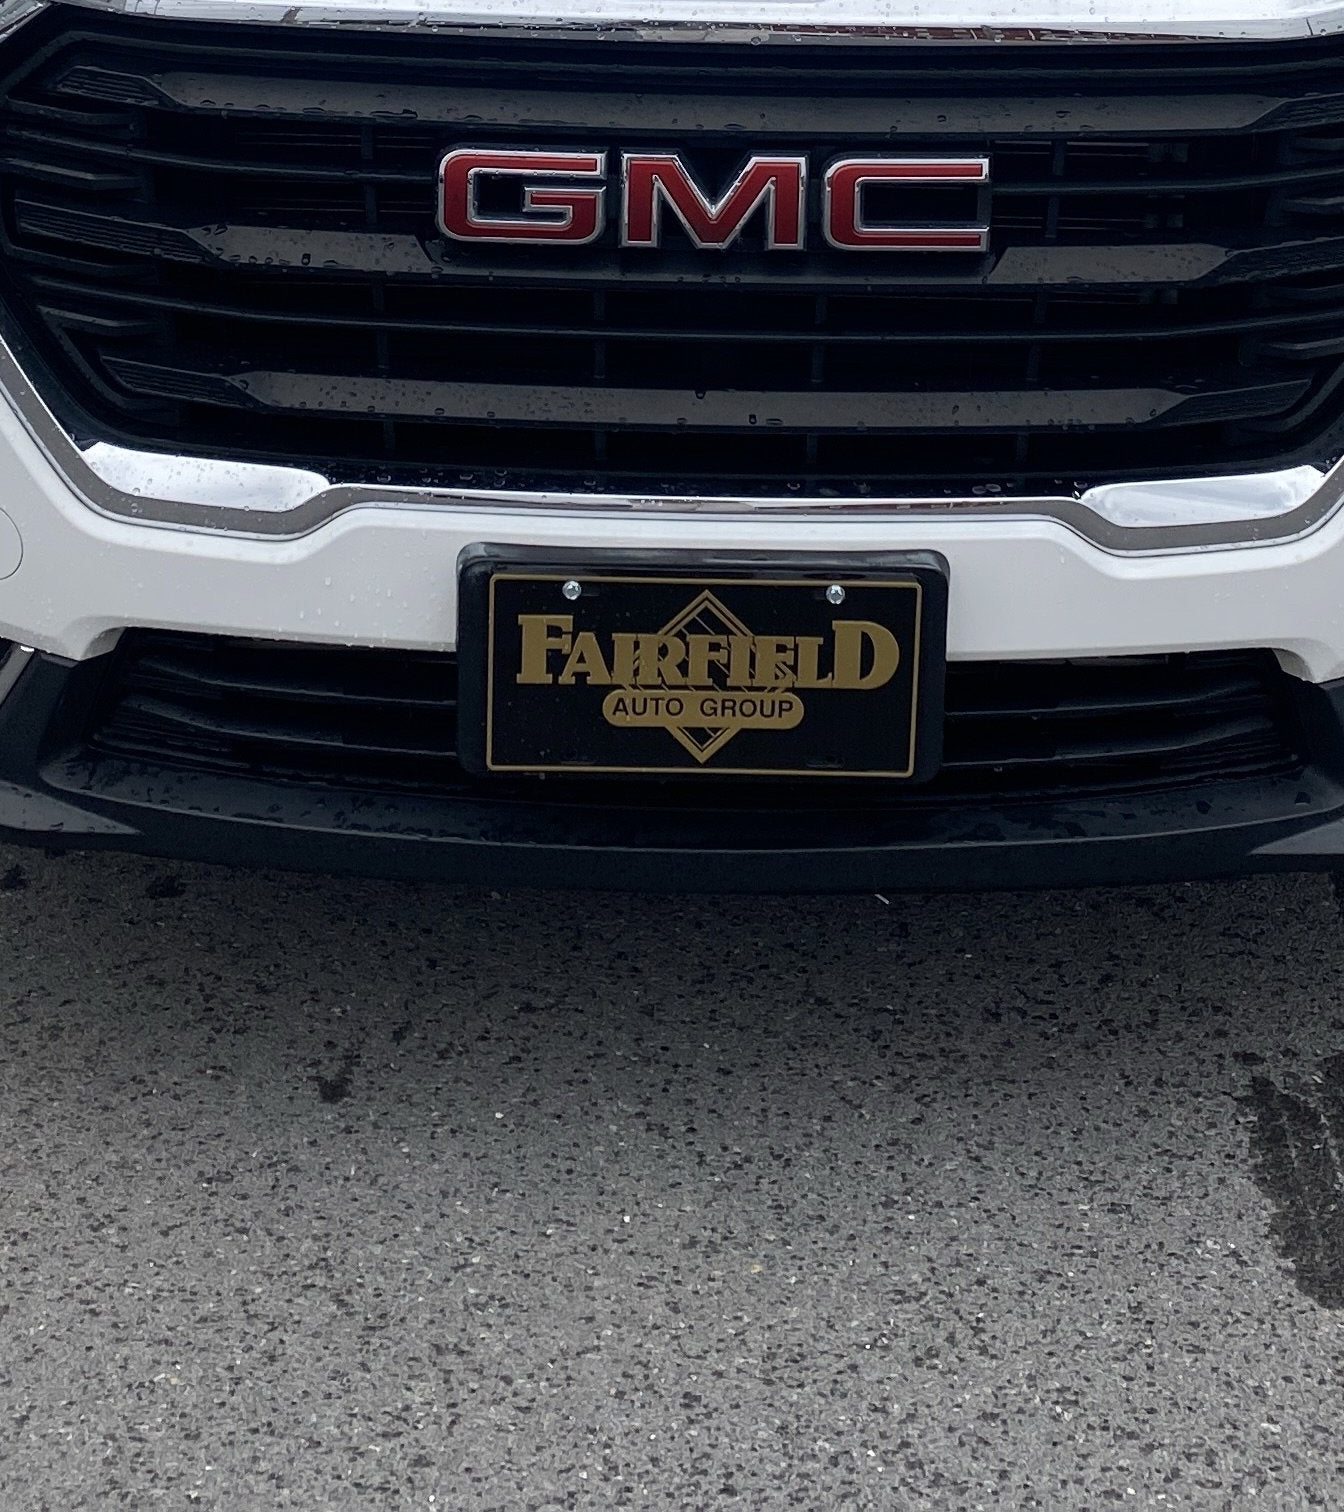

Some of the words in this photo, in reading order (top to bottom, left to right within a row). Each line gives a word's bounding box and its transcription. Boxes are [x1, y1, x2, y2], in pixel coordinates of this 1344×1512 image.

[438, 148, 991, 252] GMC
[516, 614, 900, 691] FAIRFIELD
[612, 696, 685, 718] AUTO
[699, 699, 795, 720] GROUP
